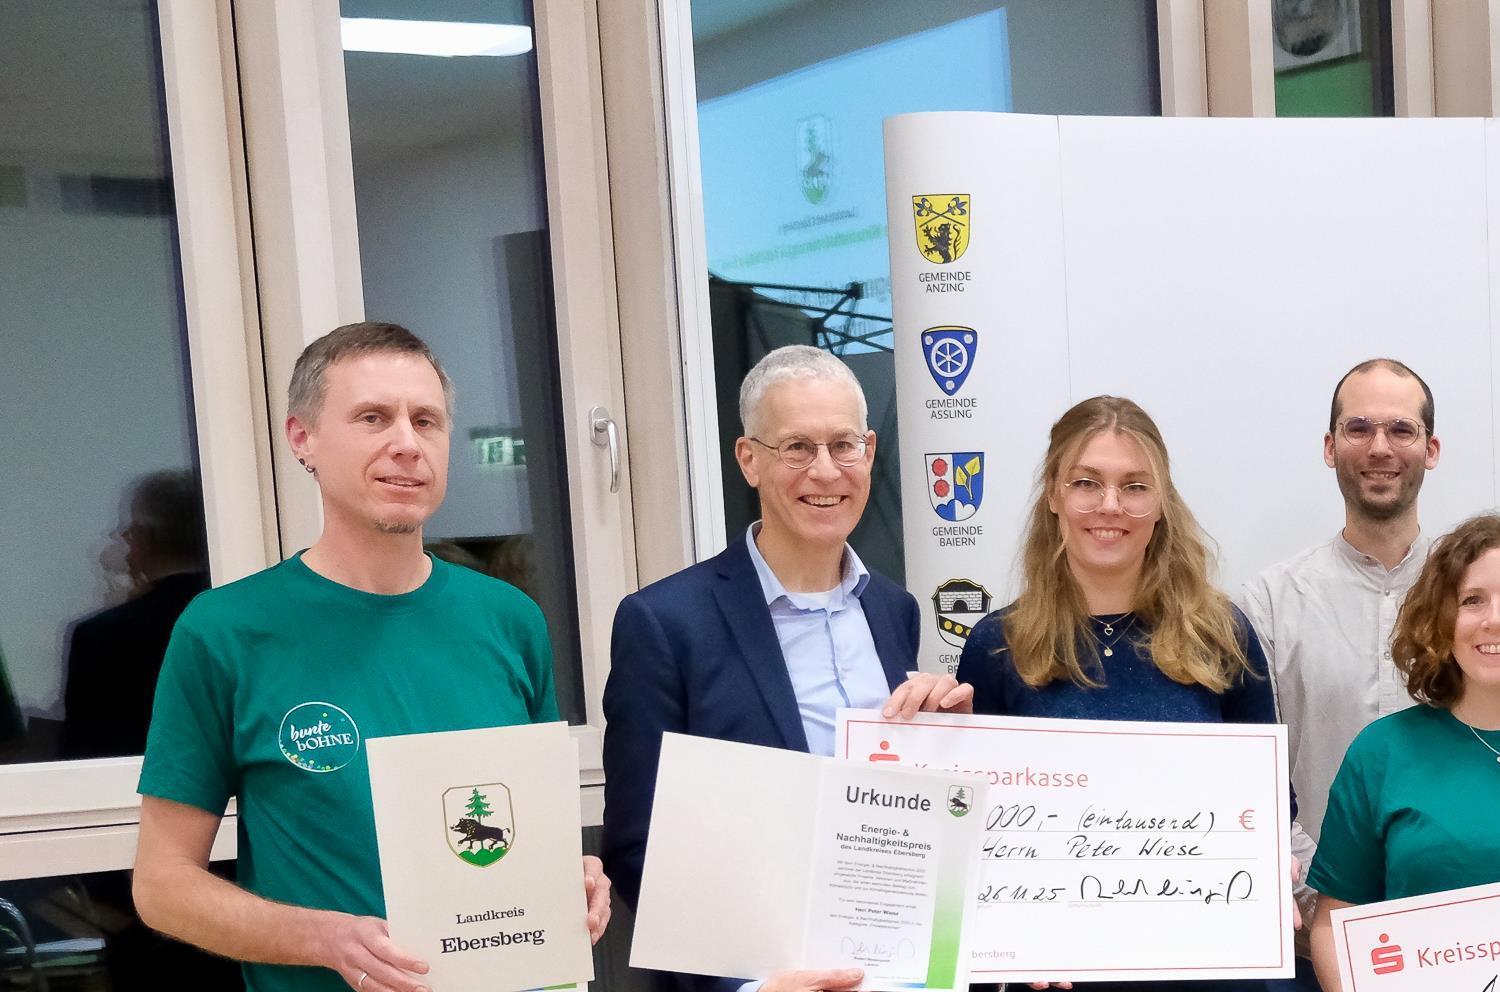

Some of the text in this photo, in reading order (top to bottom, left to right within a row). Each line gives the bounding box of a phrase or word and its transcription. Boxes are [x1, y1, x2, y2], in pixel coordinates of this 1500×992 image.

[919, 271, 972, 283] GEMEINDE
[925, 282, 965, 293] ANZING
[925, 398, 977, 410] GEMEINDE
[930, 409, 972, 420] ASSLING
[932, 526, 983, 537] GEMEINDE
[938, 536, 976, 547] BAIERN
[939, 655, 960, 664] GEM
[290, 720, 331, 741] bunte
[296, 733, 354, 752] bOHNE
[846, 785, 931, 812] Urkunde
[1238, 809, 1256, 831] €
[860, 824, 910, 837] Energie- &
[836, 833, 932, 851] Nachhaltigkeitspreis
[1067, 835, 1121, 858] Peter
[1139, 837, 1204, 857] Wiese
[893, 850, 927, 859] Ebersberg
[455, 905, 526, 925] Landkreis
[440, 926, 545, 956] Ebersberg
